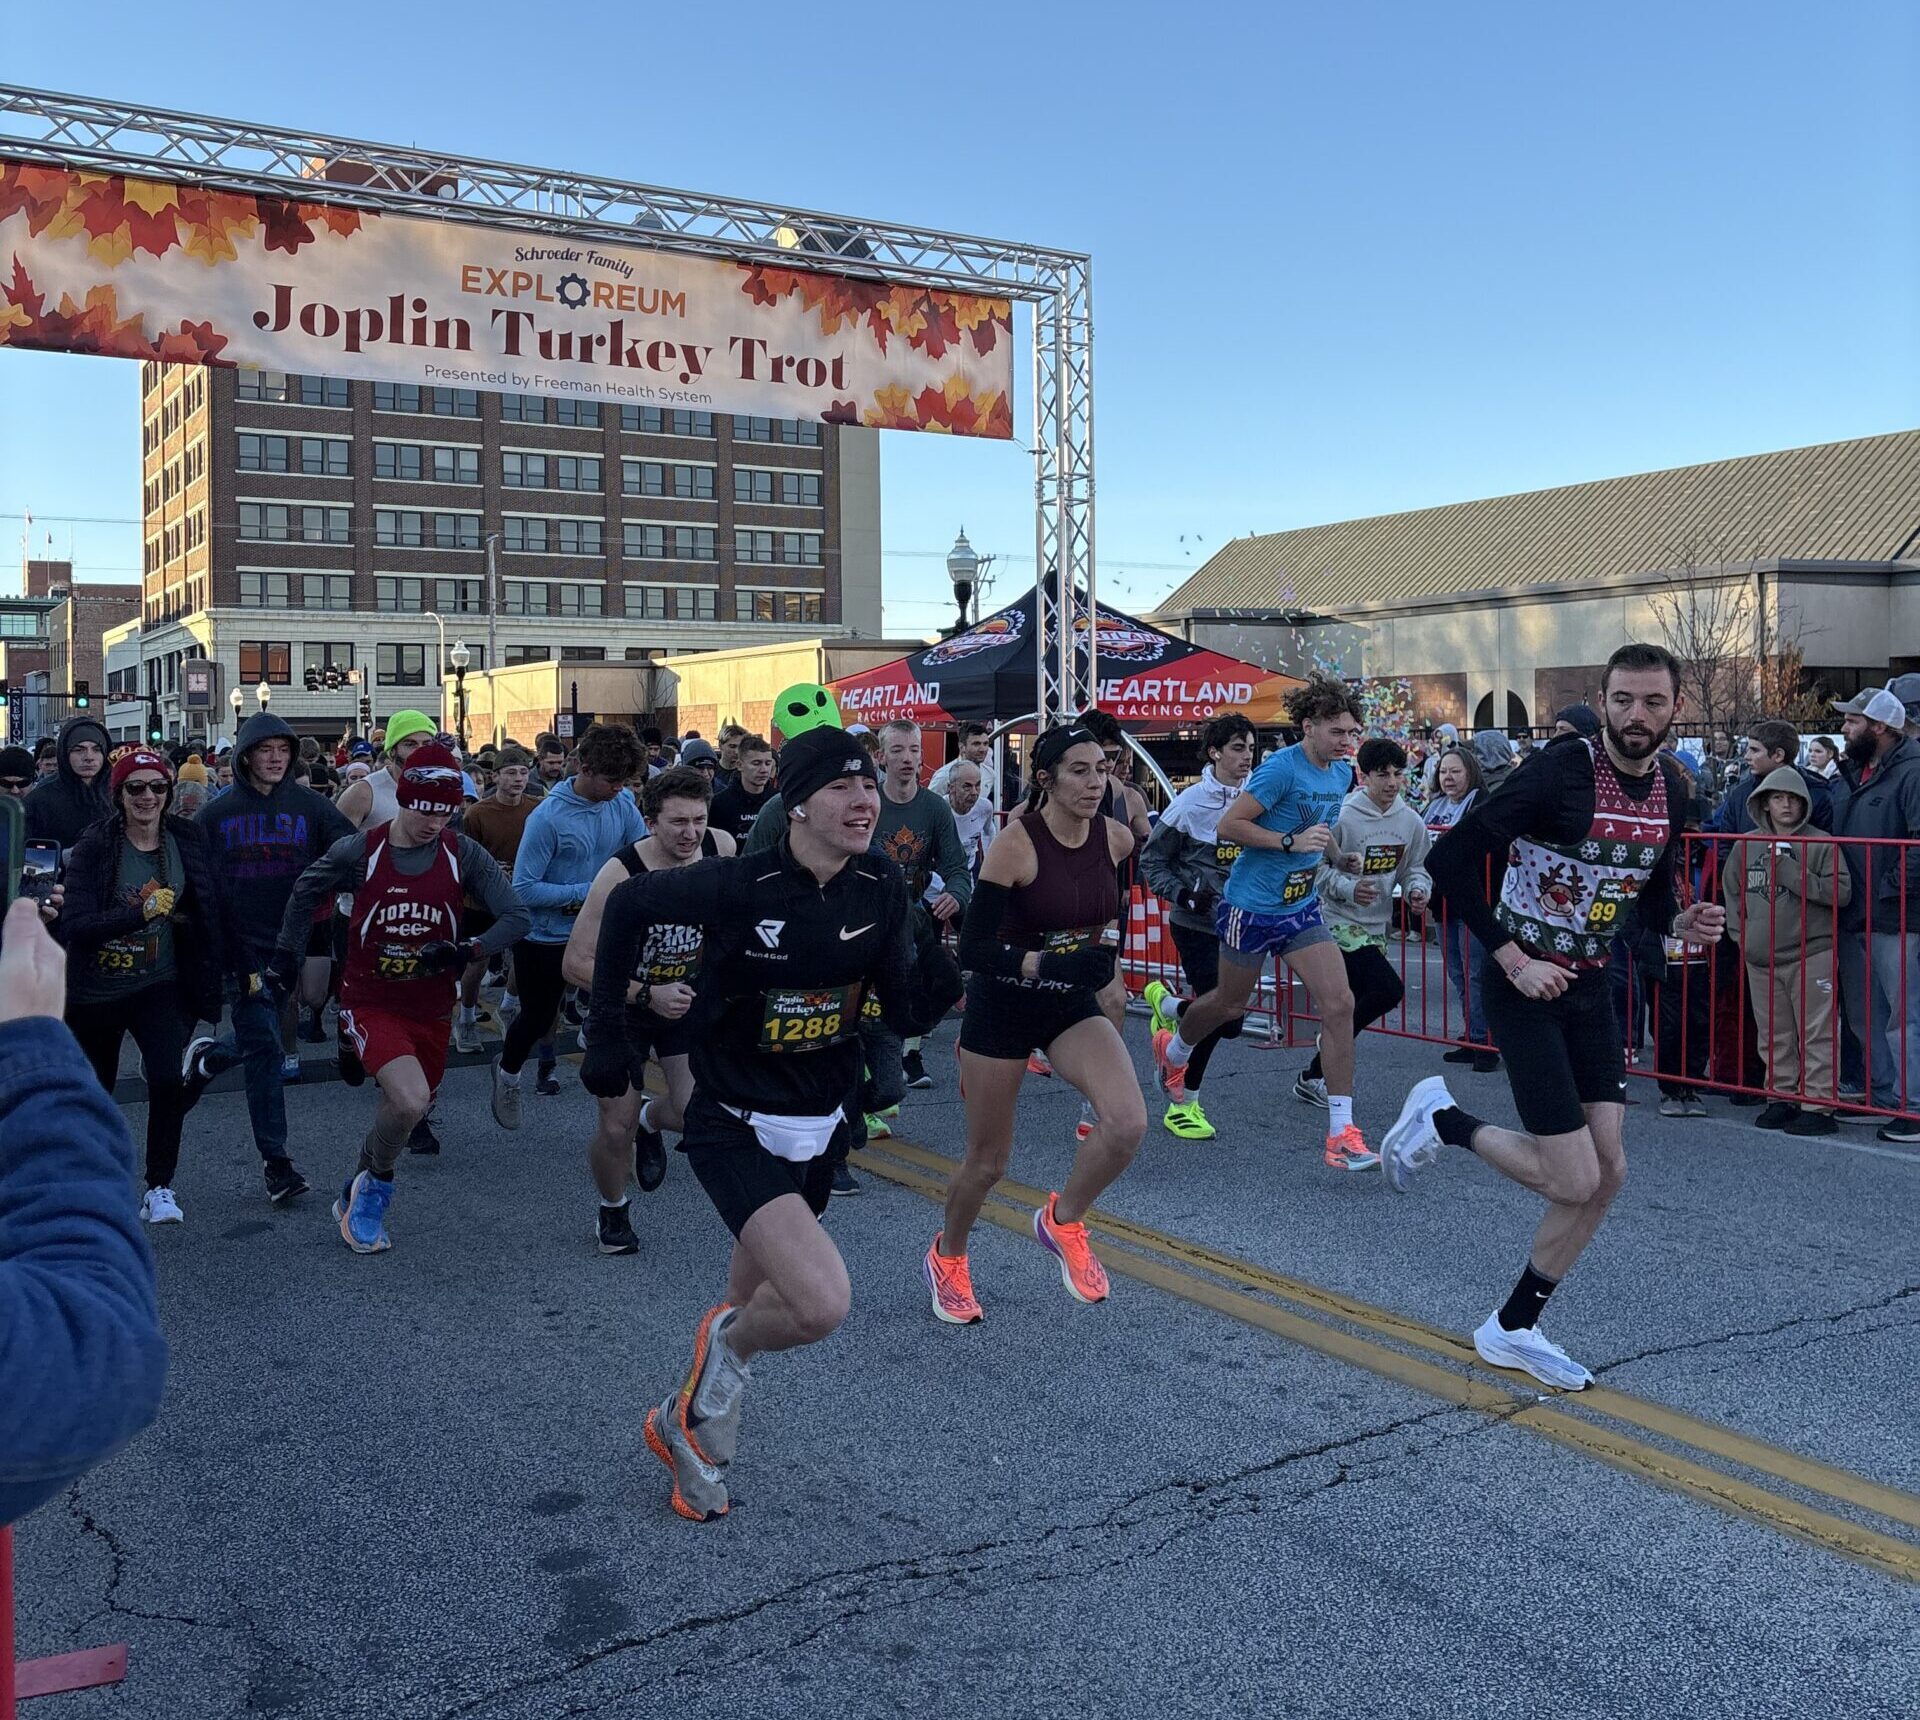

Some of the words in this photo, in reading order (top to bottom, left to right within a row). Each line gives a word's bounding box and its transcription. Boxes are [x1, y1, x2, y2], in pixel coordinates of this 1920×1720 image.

[514, 246, 583, 262] Schroeder
[586, 249, 634, 279] Family
[252, 282, 474, 354] Joplin
[491, 307, 714, 384] Turkey
[729, 335, 852, 391] Trot
[424, 364, 507, 385] Presented
[512, 372, 530, 389] by
[534, 374, 602, 394] Freeman
[605, 382, 655, 399] Health
[658, 387, 712, 404] System
[840, 682, 940, 710] HEARTLAND
[857, 709, 896, 721] RACING
[1117, 704, 1183, 716] RACING
[11, 698, 23, 745] NEWTON
[219, 812, 308, 850] TULSA
[1216, 846, 1242, 859] 666
[1364, 857, 1397, 870] 1222
[376, 902, 442, 925] JOPLIN
[1588, 902, 1617, 922] 89
[97, 950, 134, 968] 733
[744, 949, 789, 960] Run4God
[379, 956, 418, 973] 737
[648, 965, 687, 977] 440
[777, 995, 805, 1004] Joplin
[773, 1004, 816, 1016] Turkey
[818, 1002, 841, 1011] Trot
[765, 1014, 841, 1041] 1288
